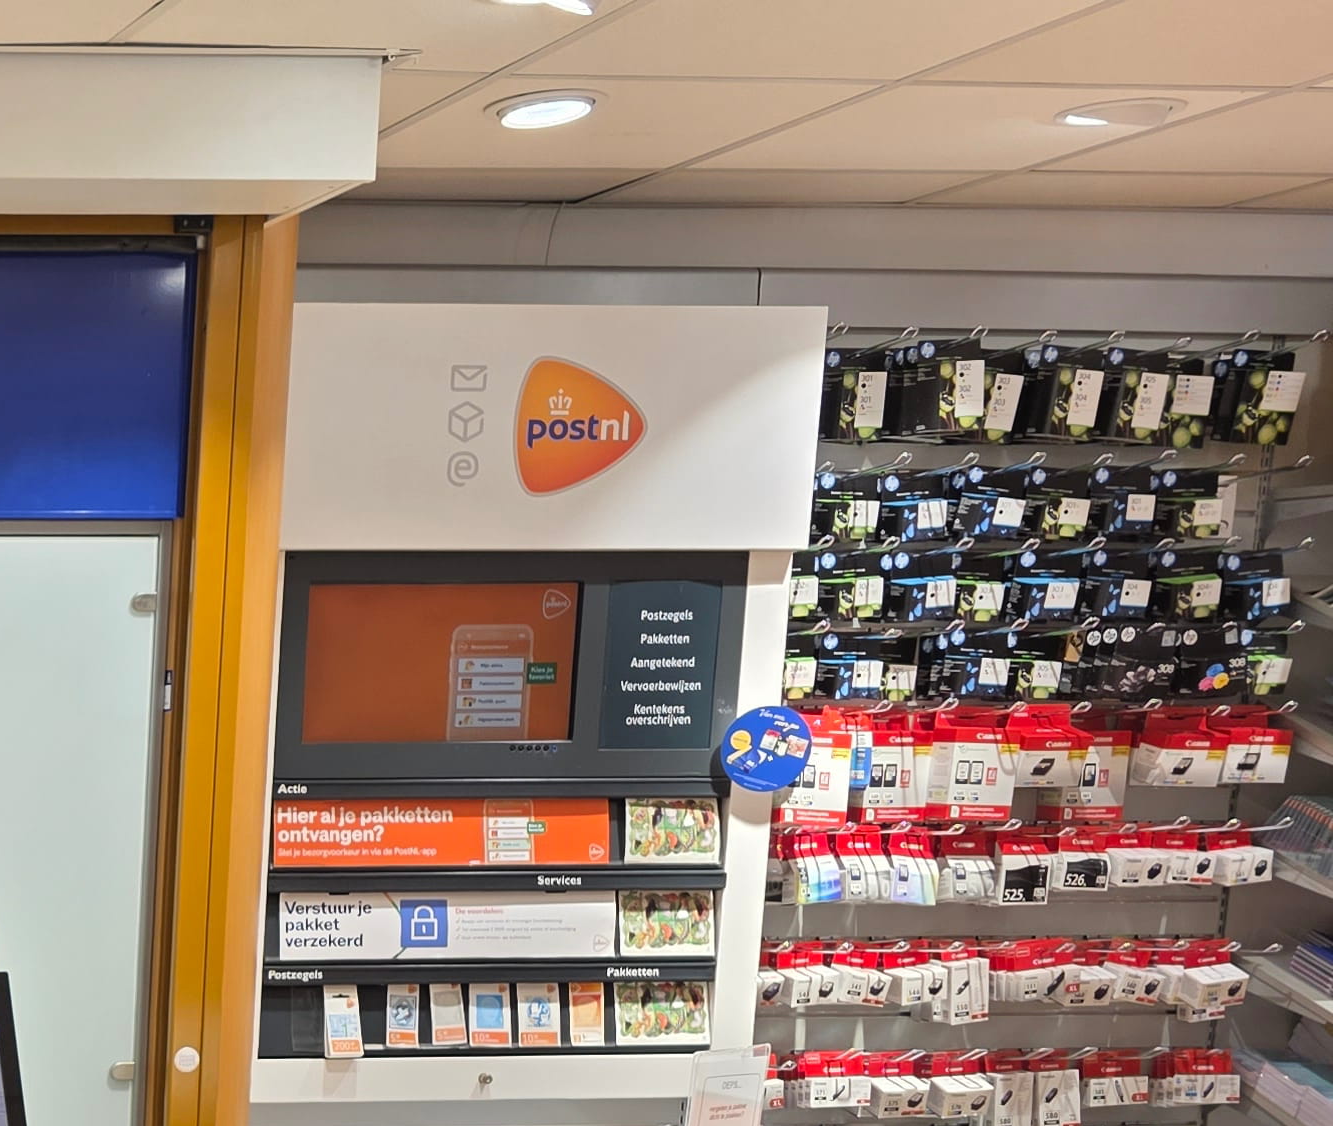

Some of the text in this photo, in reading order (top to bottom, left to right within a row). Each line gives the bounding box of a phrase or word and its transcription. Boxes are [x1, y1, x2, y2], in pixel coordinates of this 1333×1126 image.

[526, 410, 630, 449] postnl
[640, 609, 693, 623] Postzegels
[640, 633, 690, 644] Pakketten
[630, 657, 695, 670] Aangetekend
[620, 680, 701, 693] Vervoerbewijzen
[633, 704, 685, 715] Kentekens
[625, 714, 691, 727] overschrijven
[277, 784, 307, 795] Actie
[277, 807, 453, 827] Hier al je pakketten
[278, 825, 384, 846] ontvangen?
[537, 875, 582, 886] Services
[285, 901, 372, 916] Verstuur je
[285, 918, 340, 933] pakket
[285, 933, 364, 948] verzekerd
[268, 966, 660, 983] Postzegels Pakketten
[772, 1099, 782, 1107] XL
